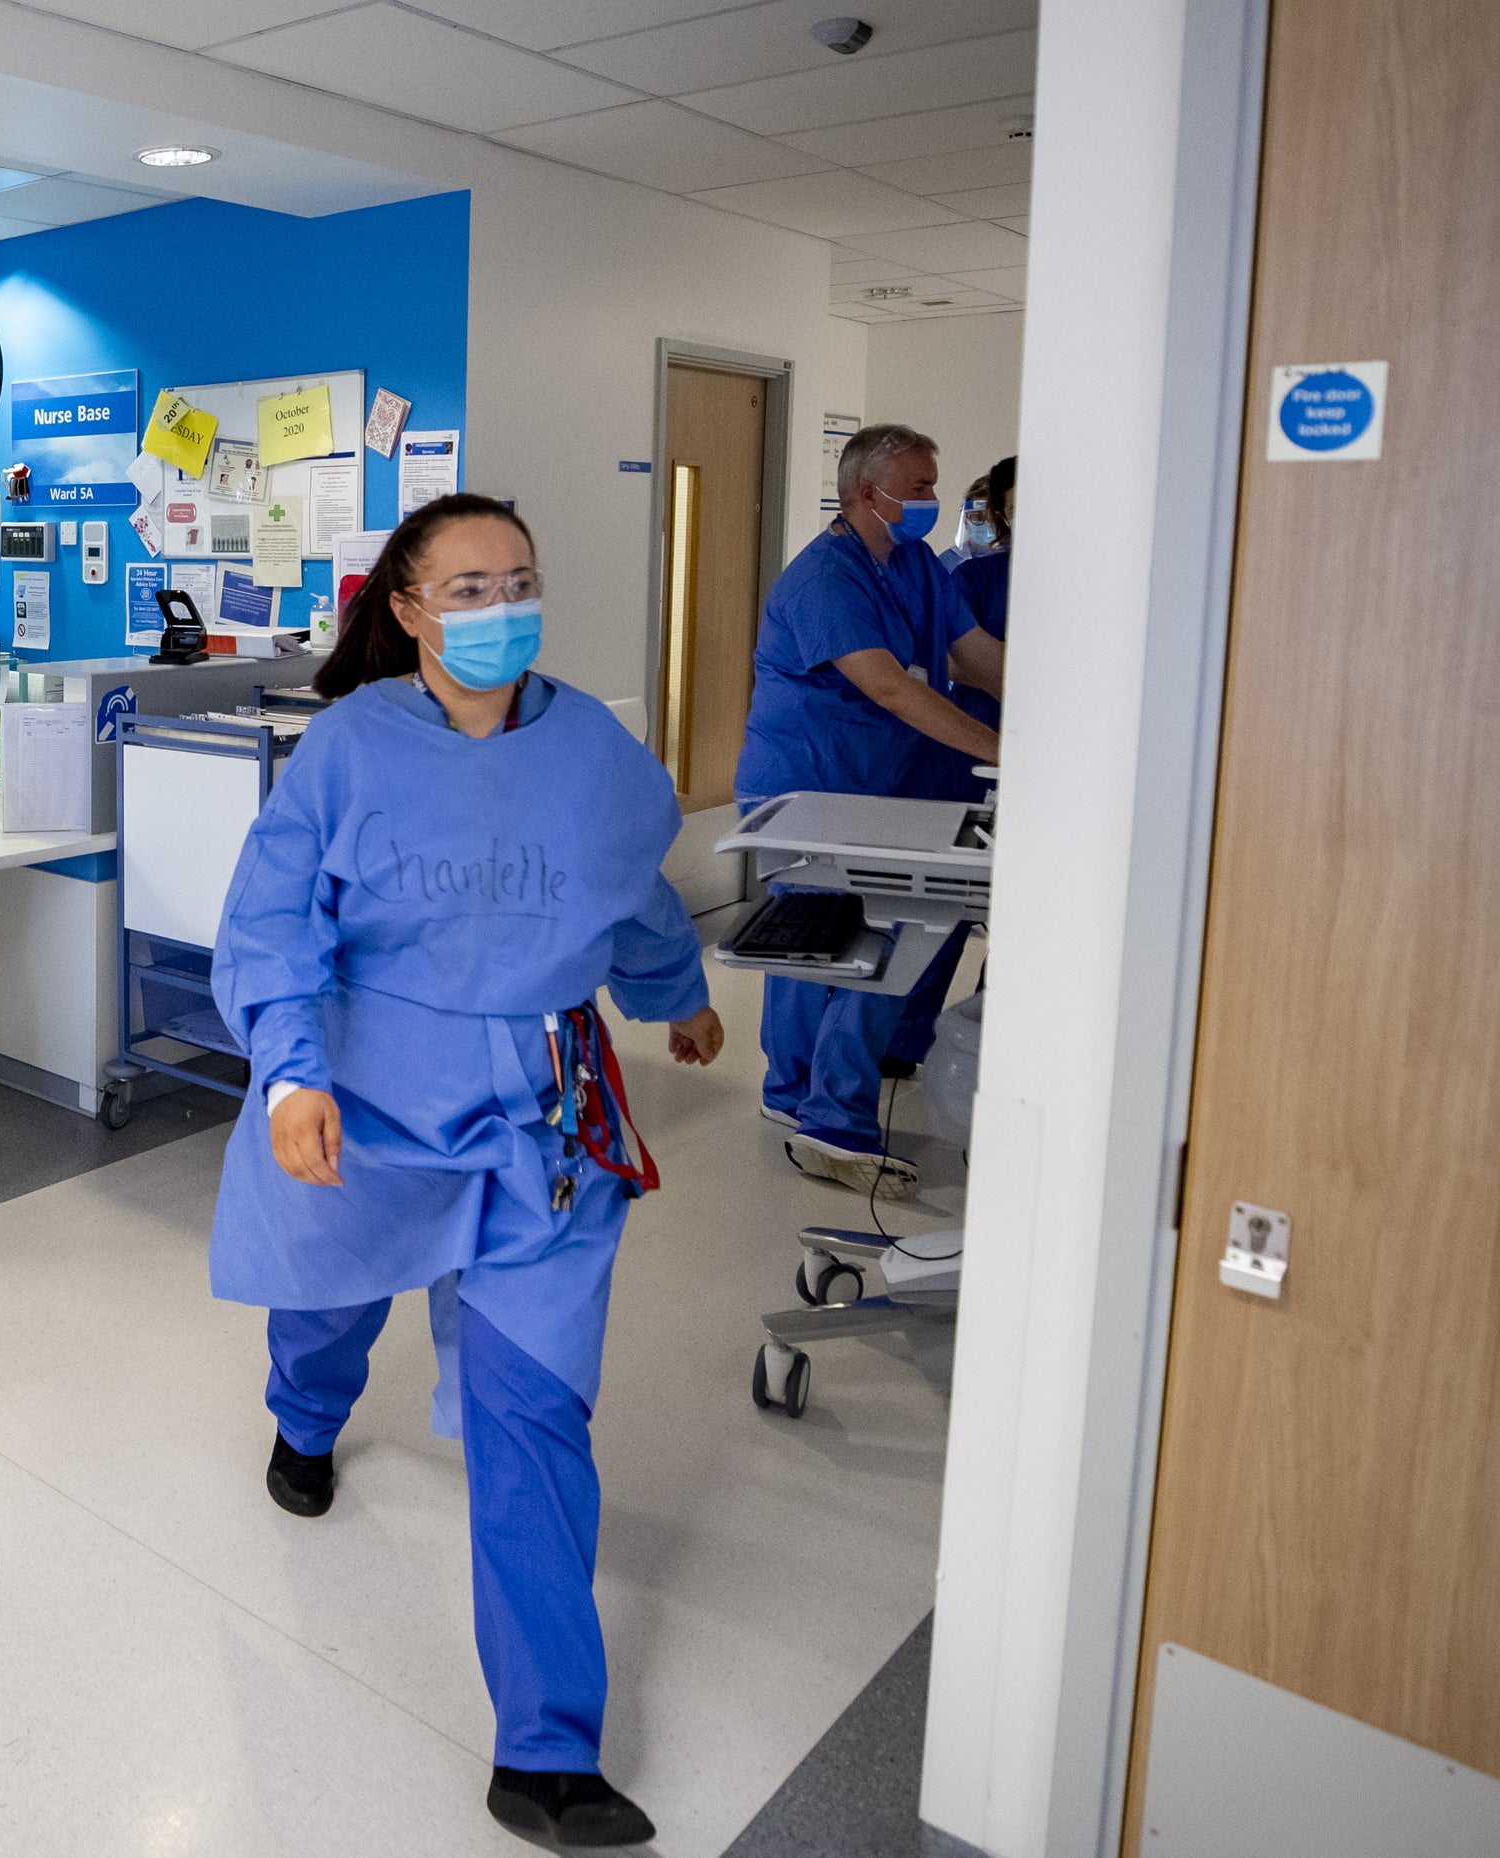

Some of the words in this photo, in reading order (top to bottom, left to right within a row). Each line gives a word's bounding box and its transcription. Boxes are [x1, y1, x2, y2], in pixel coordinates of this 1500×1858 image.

[1292, 388, 1322, 402] Fire
[1324, 388, 1362, 402] door
[34, 408, 73, 425] Nurse
[77, 405, 111, 422] Base
[163, 401, 180, 424] 20th
[275, 405, 310, 422] October
[1304, 406, 1346, 420] keep
[283, 423, 305, 438] 2020
[1297, 423, 1352, 437] locked
[49, 486, 77, 500] Ward
[80, 487, 94, 500] 5A
[135, 569, 143, 577] 24
[143, 569, 158, 577] Hour
[353, 810, 567, 907] Chantelle
